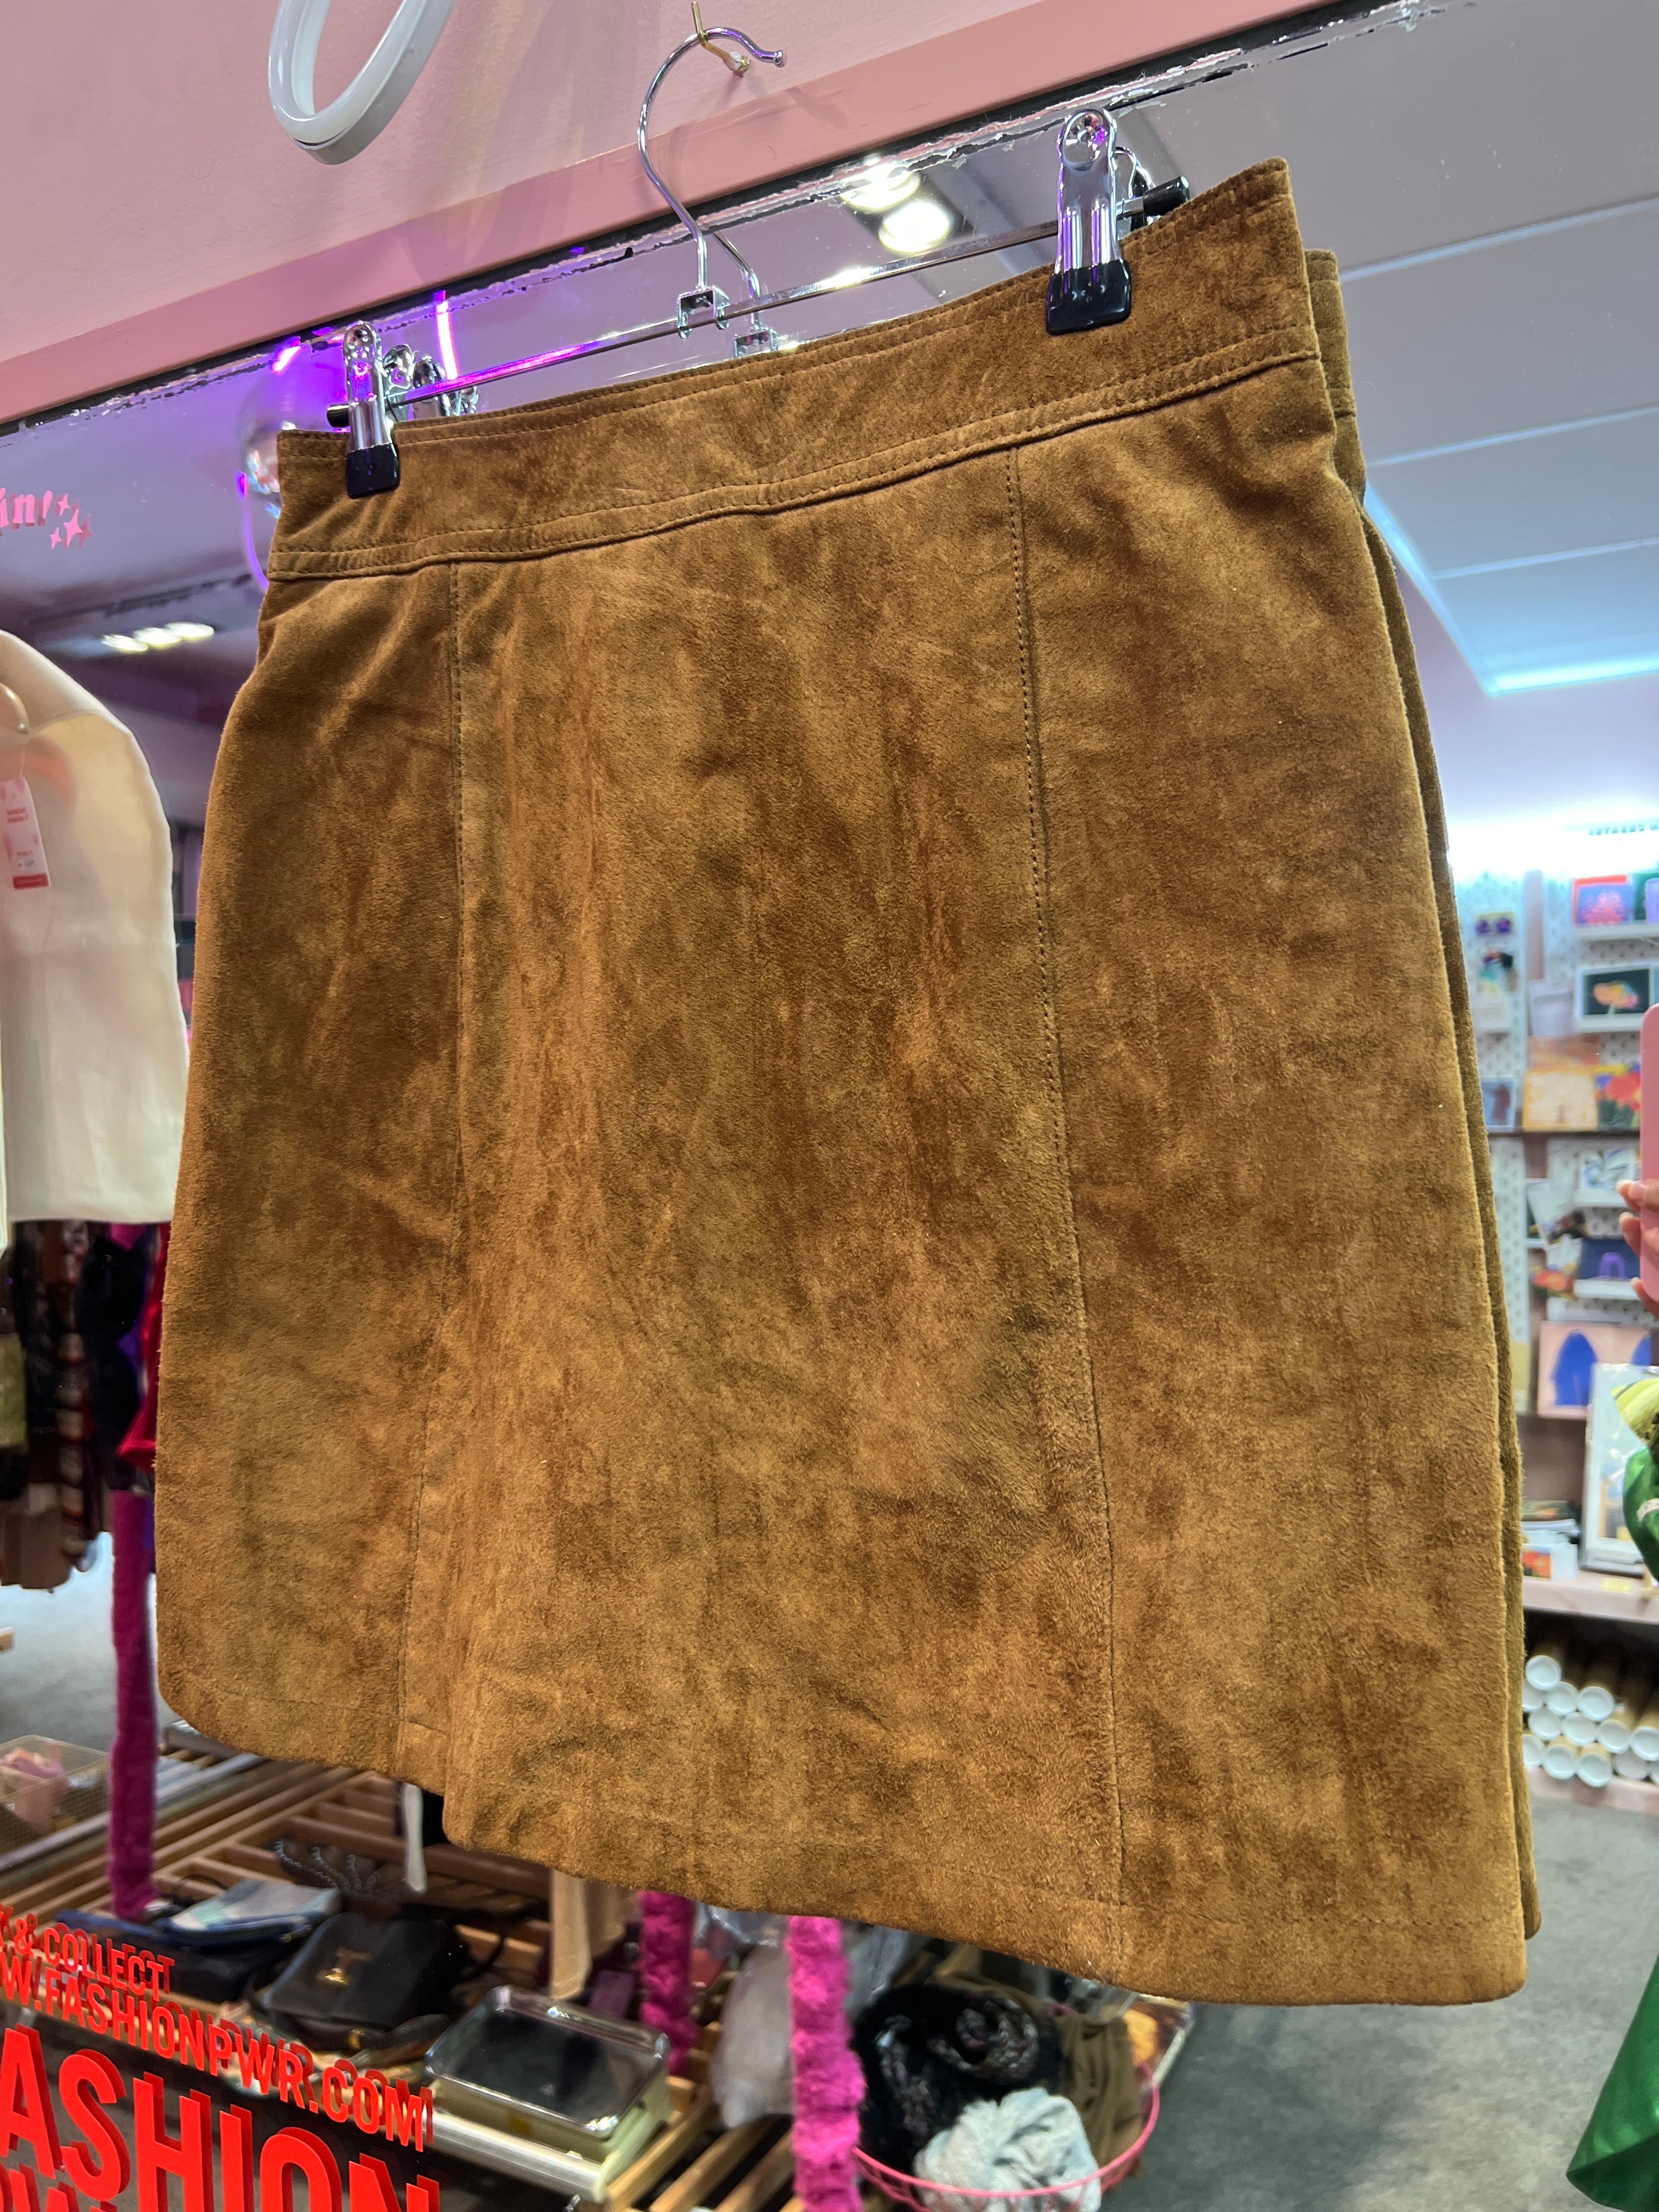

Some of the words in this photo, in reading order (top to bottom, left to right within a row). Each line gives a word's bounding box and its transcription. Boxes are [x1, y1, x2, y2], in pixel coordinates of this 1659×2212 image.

[14, 1918, 34, 1958] &
[44, 1927, 164, 2002] COLLECT
[0, 2028, 429, 2212] ASHI
